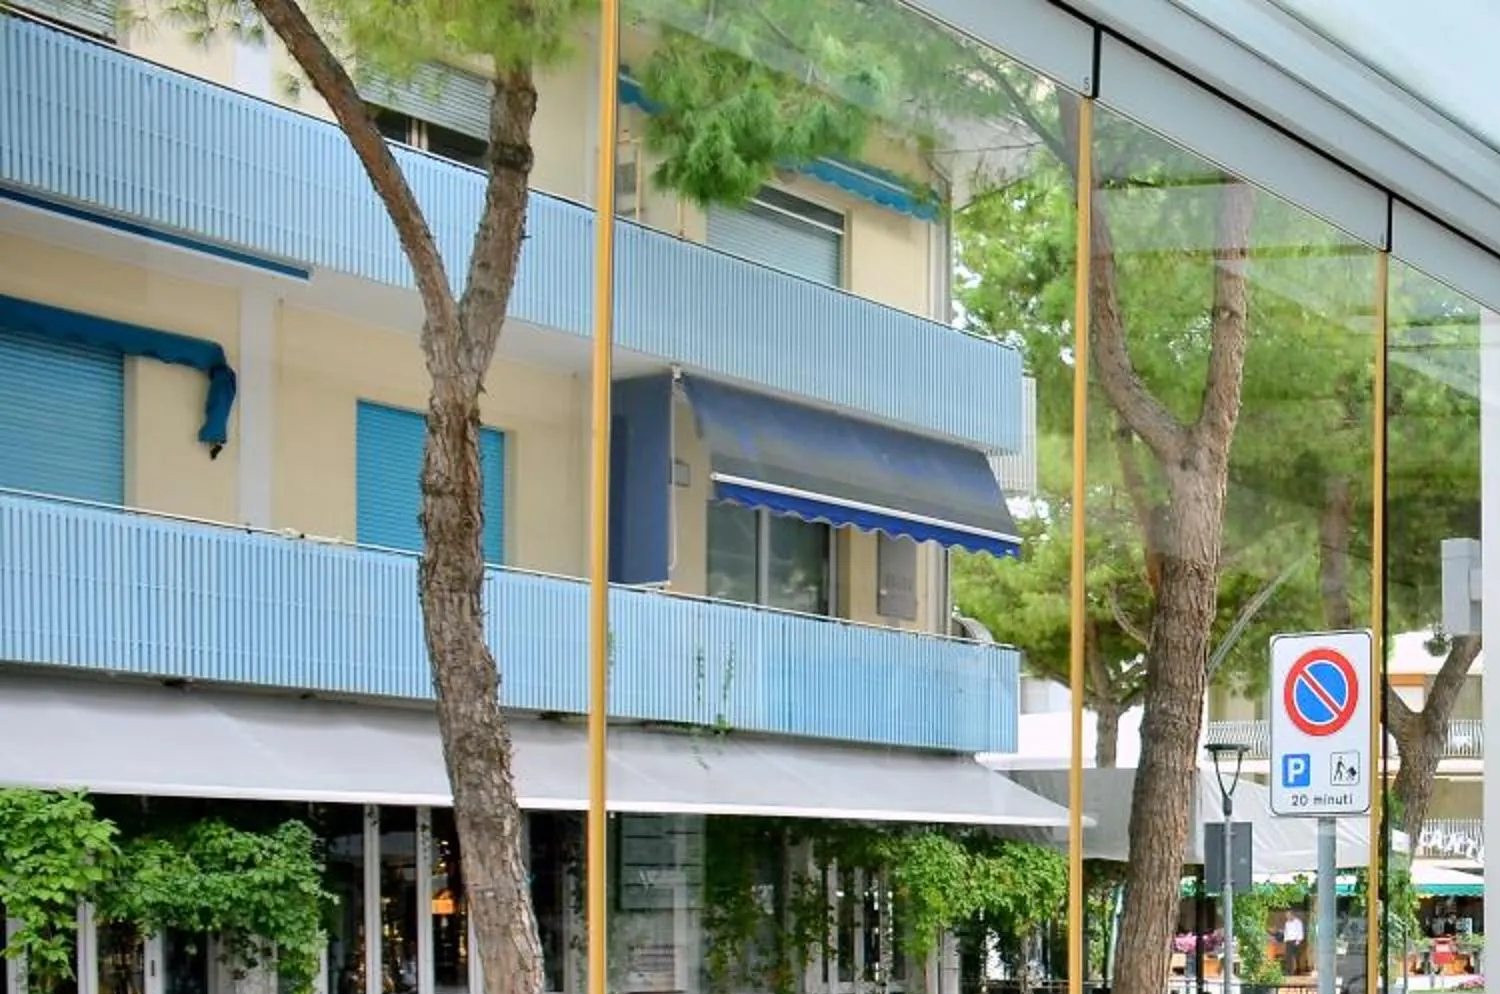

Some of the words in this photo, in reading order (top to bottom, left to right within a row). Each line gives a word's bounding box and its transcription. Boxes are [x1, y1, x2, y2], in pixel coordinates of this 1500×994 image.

[1287, 757, 1305, 784] P
[1291, 794, 1309, 806] 20
[1313, 793, 1353, 805] minuti
